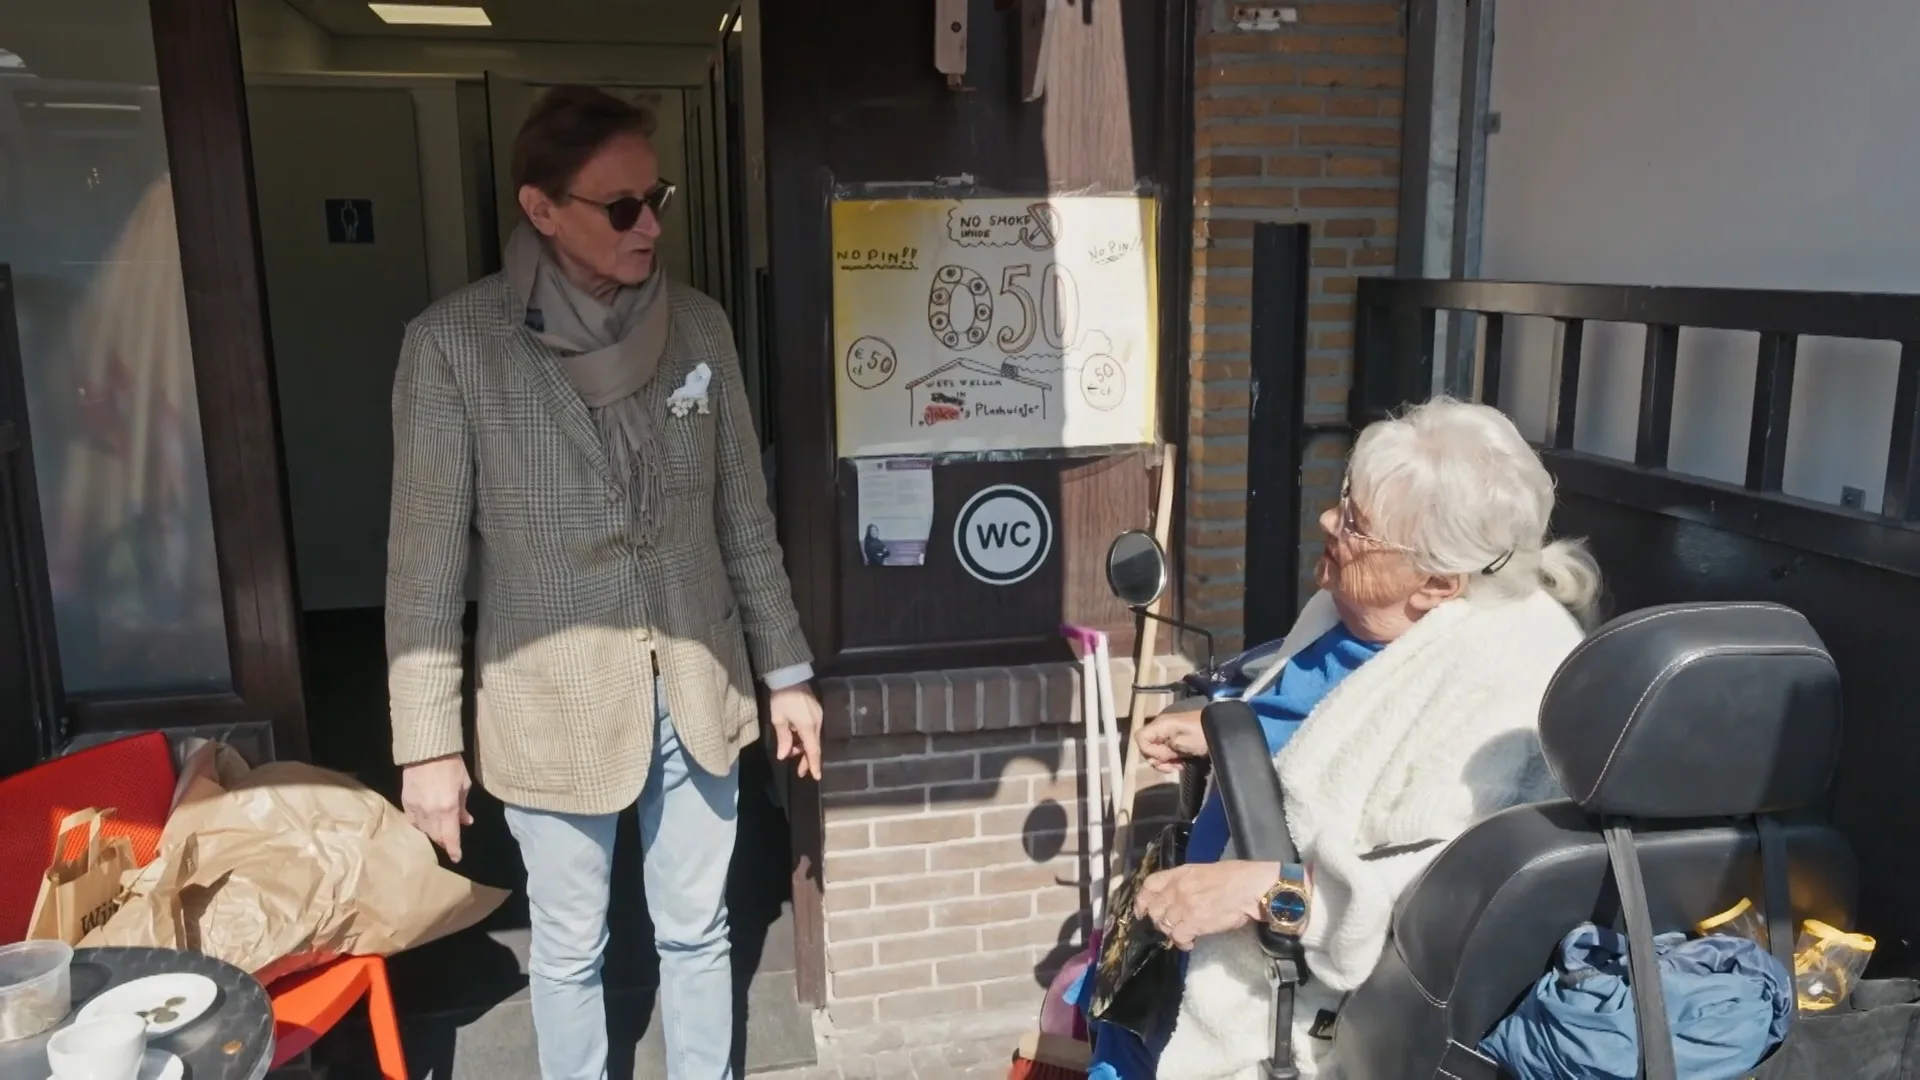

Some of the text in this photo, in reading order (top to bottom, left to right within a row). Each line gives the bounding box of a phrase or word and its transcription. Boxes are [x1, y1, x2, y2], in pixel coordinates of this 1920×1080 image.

[960, 214, 1032, 228] NO SMOKE
[960, 229, 991, 238] INSIDE
[837, 249, 861, 260] NO
[928, 262, 1080, 354] 050
[867, 350, 893, 374] 50
[976, 521, 1031, 550] WC
